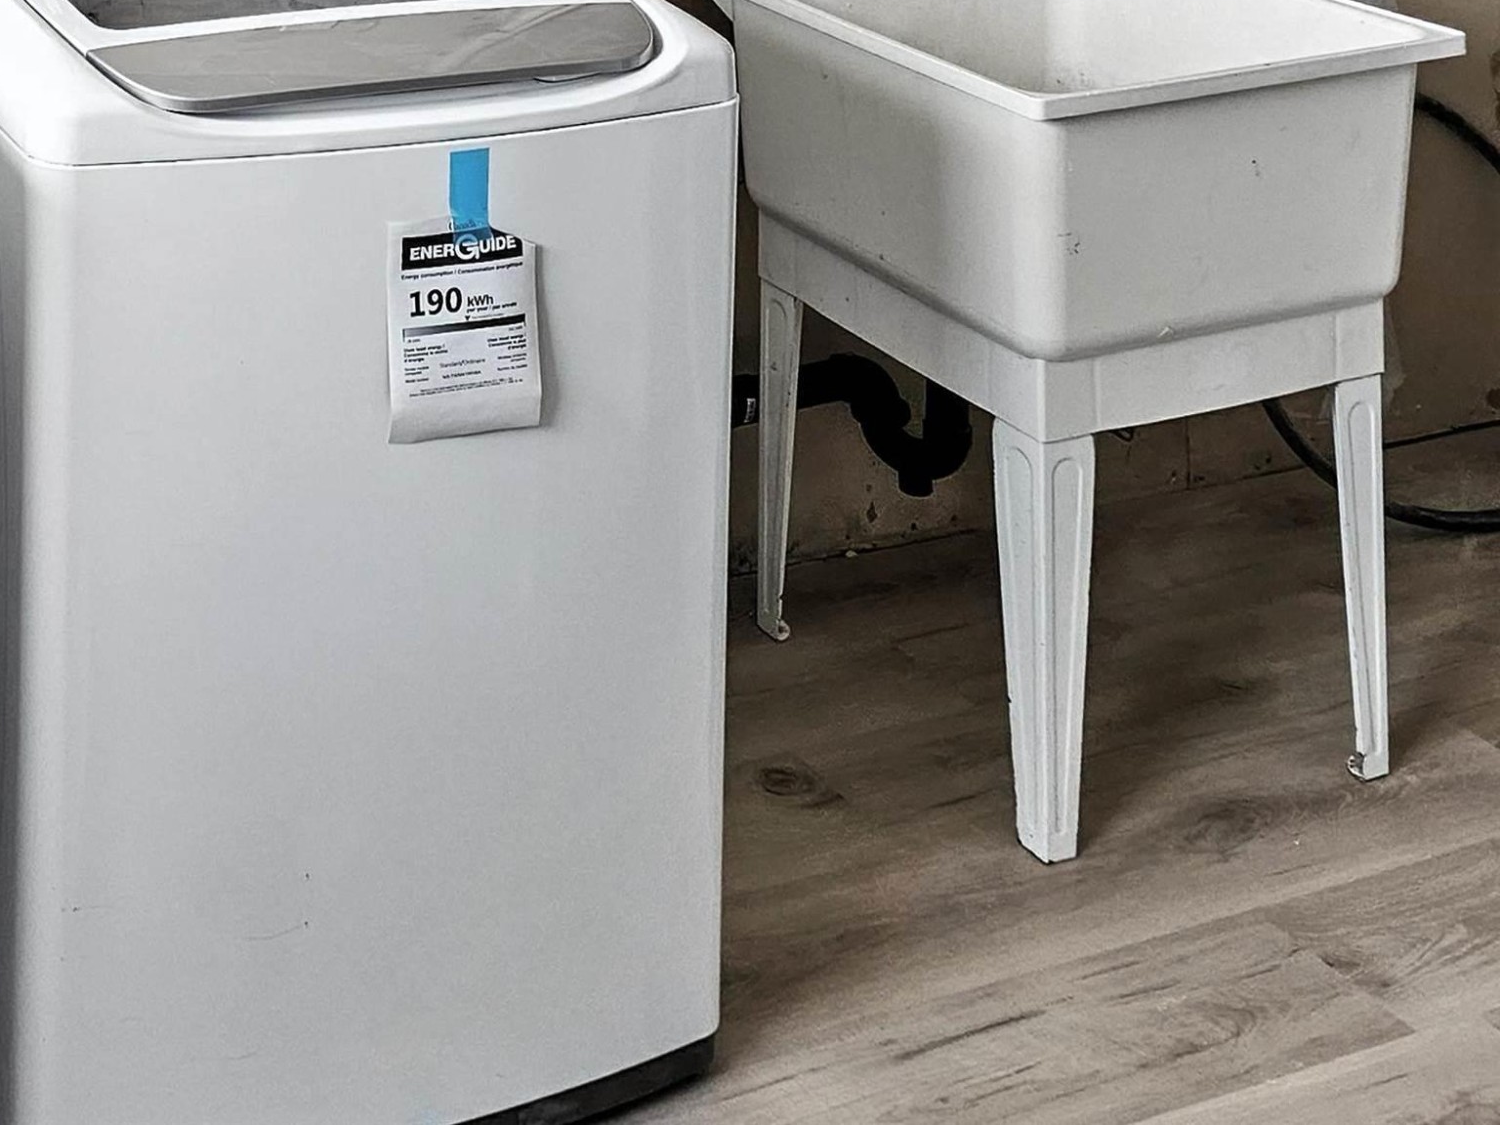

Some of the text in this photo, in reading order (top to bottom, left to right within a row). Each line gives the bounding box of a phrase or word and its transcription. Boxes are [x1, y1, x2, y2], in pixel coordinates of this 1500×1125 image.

[409, 234, 517, 261] ENERGUIDE
[409, 286, 463, 318] 190
[467, 294, 495, 307] kWh
